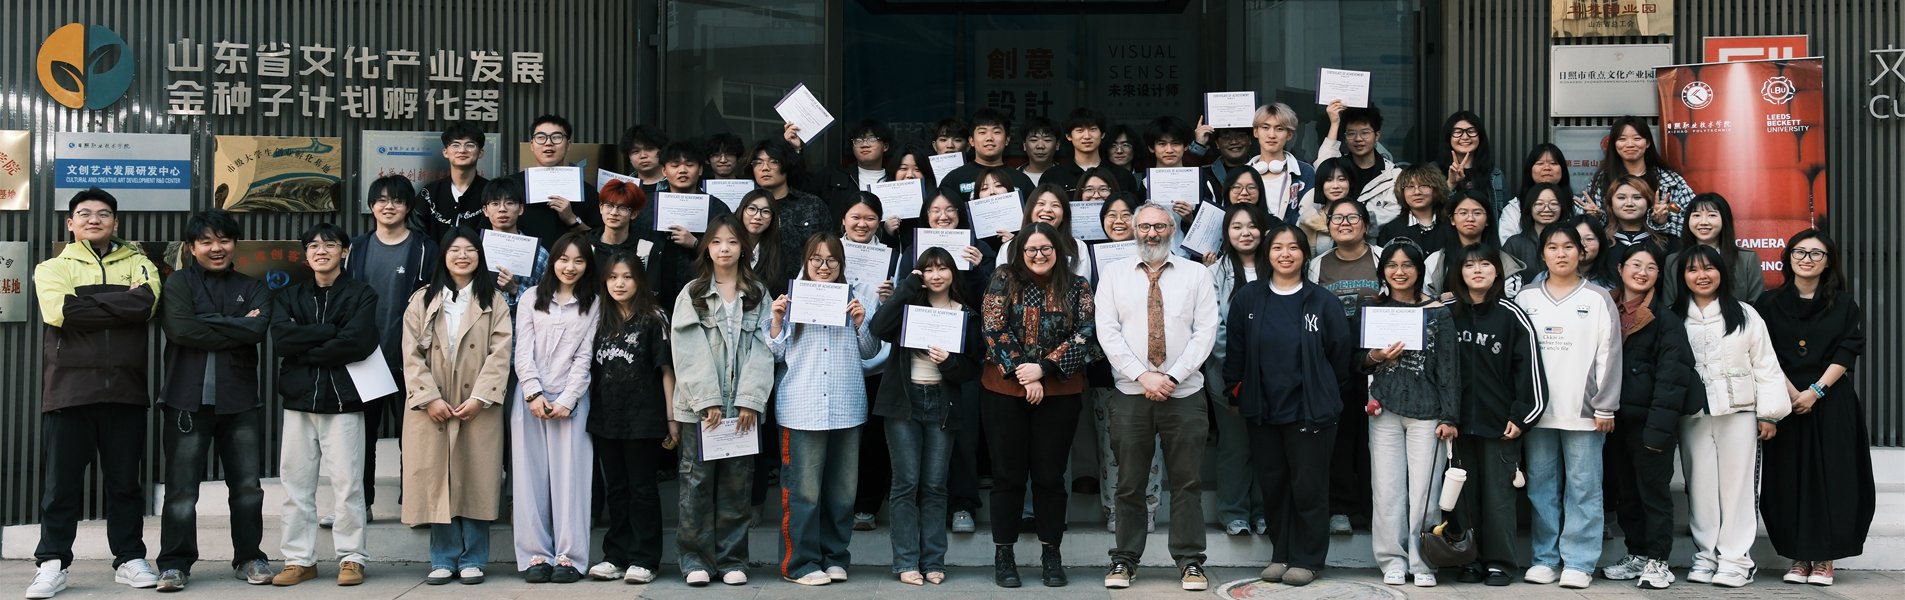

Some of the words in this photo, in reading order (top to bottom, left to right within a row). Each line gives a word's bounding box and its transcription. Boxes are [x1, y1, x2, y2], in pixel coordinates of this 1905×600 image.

[1108, 44, 1177, 59] VISUAL
[168, 38, 544, 84] 山东省文化产业发展
[988, 48, 1054, 79] 創意
[1109, 65, 1178, 79] SENSE
[1560, 70, 1657, 79] 日照市重点文化产业园
[168, 80, 499, 122] 金种子计划孵化器
[66, 164, 180, 176] 文创艺术发展研发中心
[1735, 238, 1785, 248] CAMERA
[1304, 313, 1318, 332] NY
